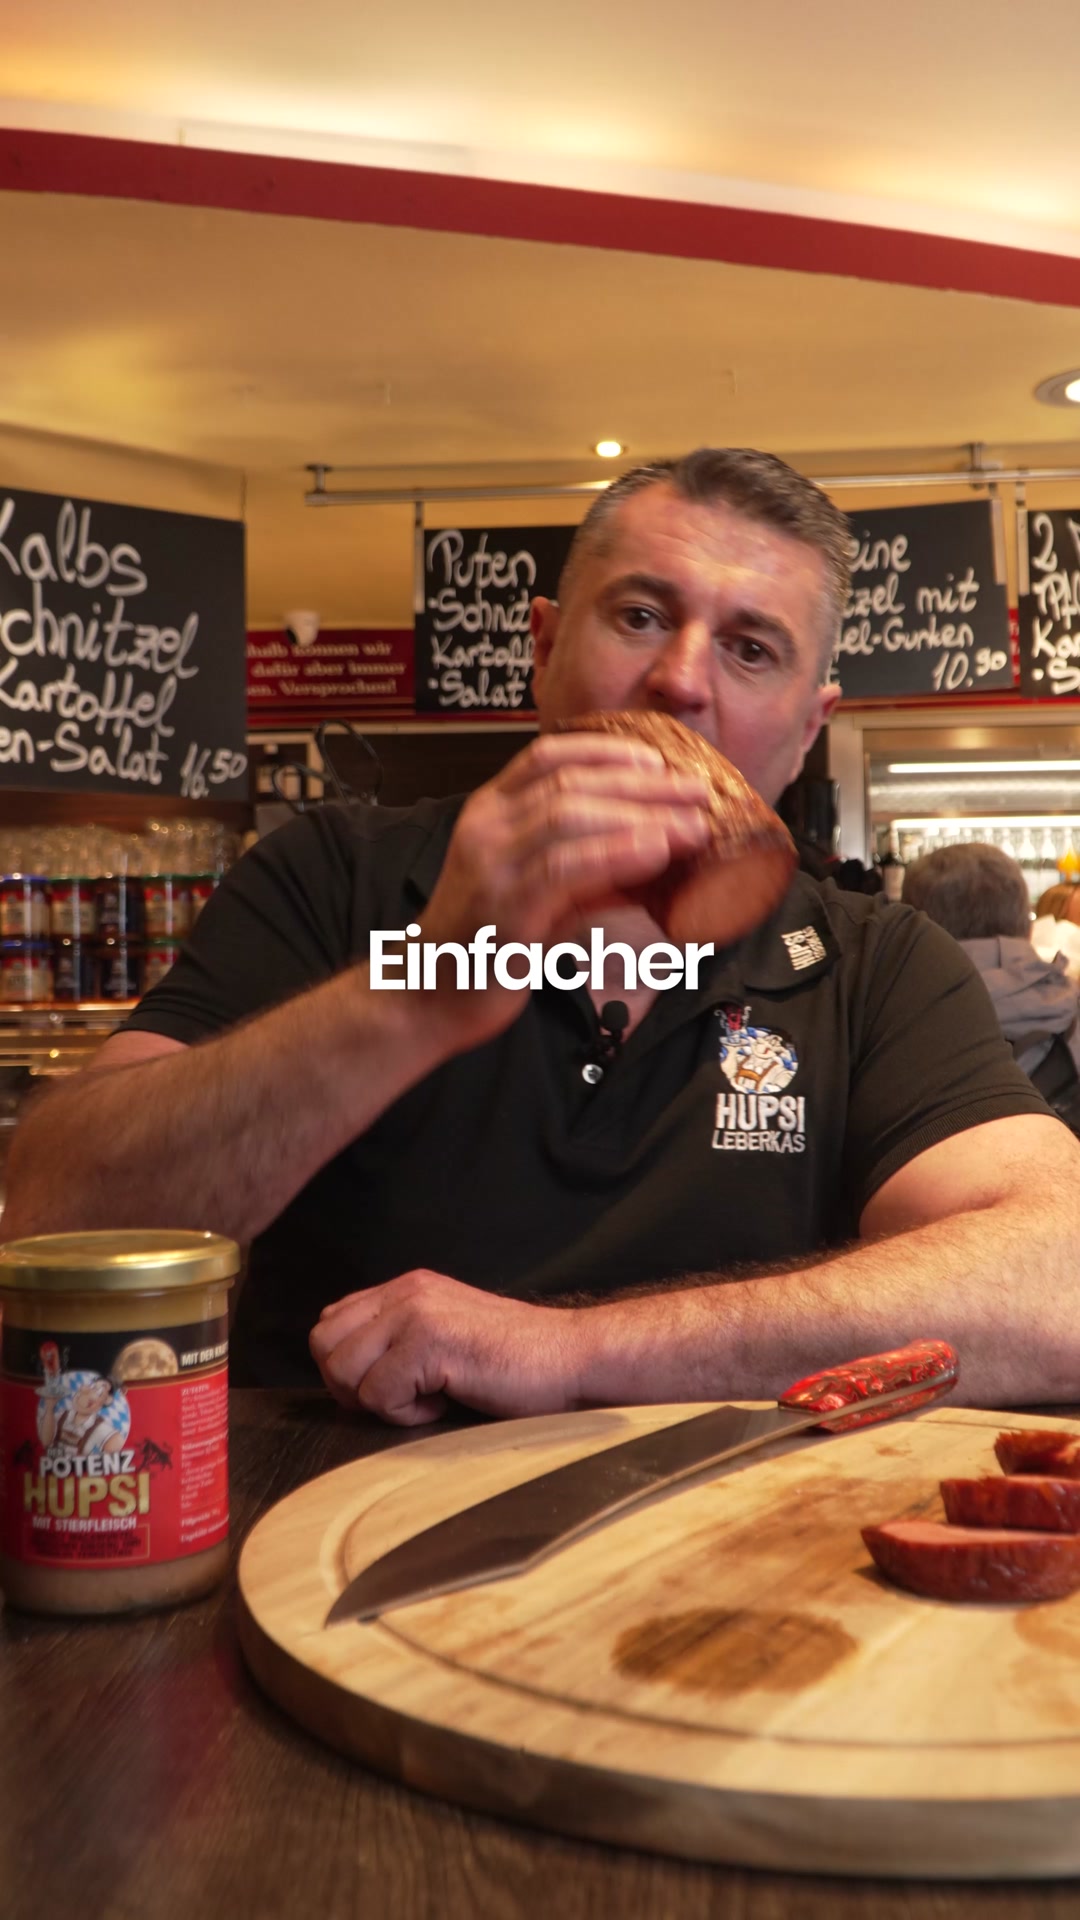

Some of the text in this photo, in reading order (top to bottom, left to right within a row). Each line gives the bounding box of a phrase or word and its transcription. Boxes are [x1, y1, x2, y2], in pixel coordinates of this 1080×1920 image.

[427, 529, 537, 589] Puten
[1032, 513, 1058, 572] 2
[433, 587, 559, 632] Schnit
[916, 567, 980, 614] mit
[0, 578, 199, 679] chnitzel
[439, 668, 527, 708] Salat
[715, 1092, 806, 1133] HUPSI
[711, 1129, 807, 1154] LEBERKAS
[181, 1352, 199, 1367] MIT
[40, 1450, 136, 1479] POTENZ
[24, 1472, 150, 1518] HUPSI
[32, 1516, 137, 1533] MIT STIERFLEISCH
